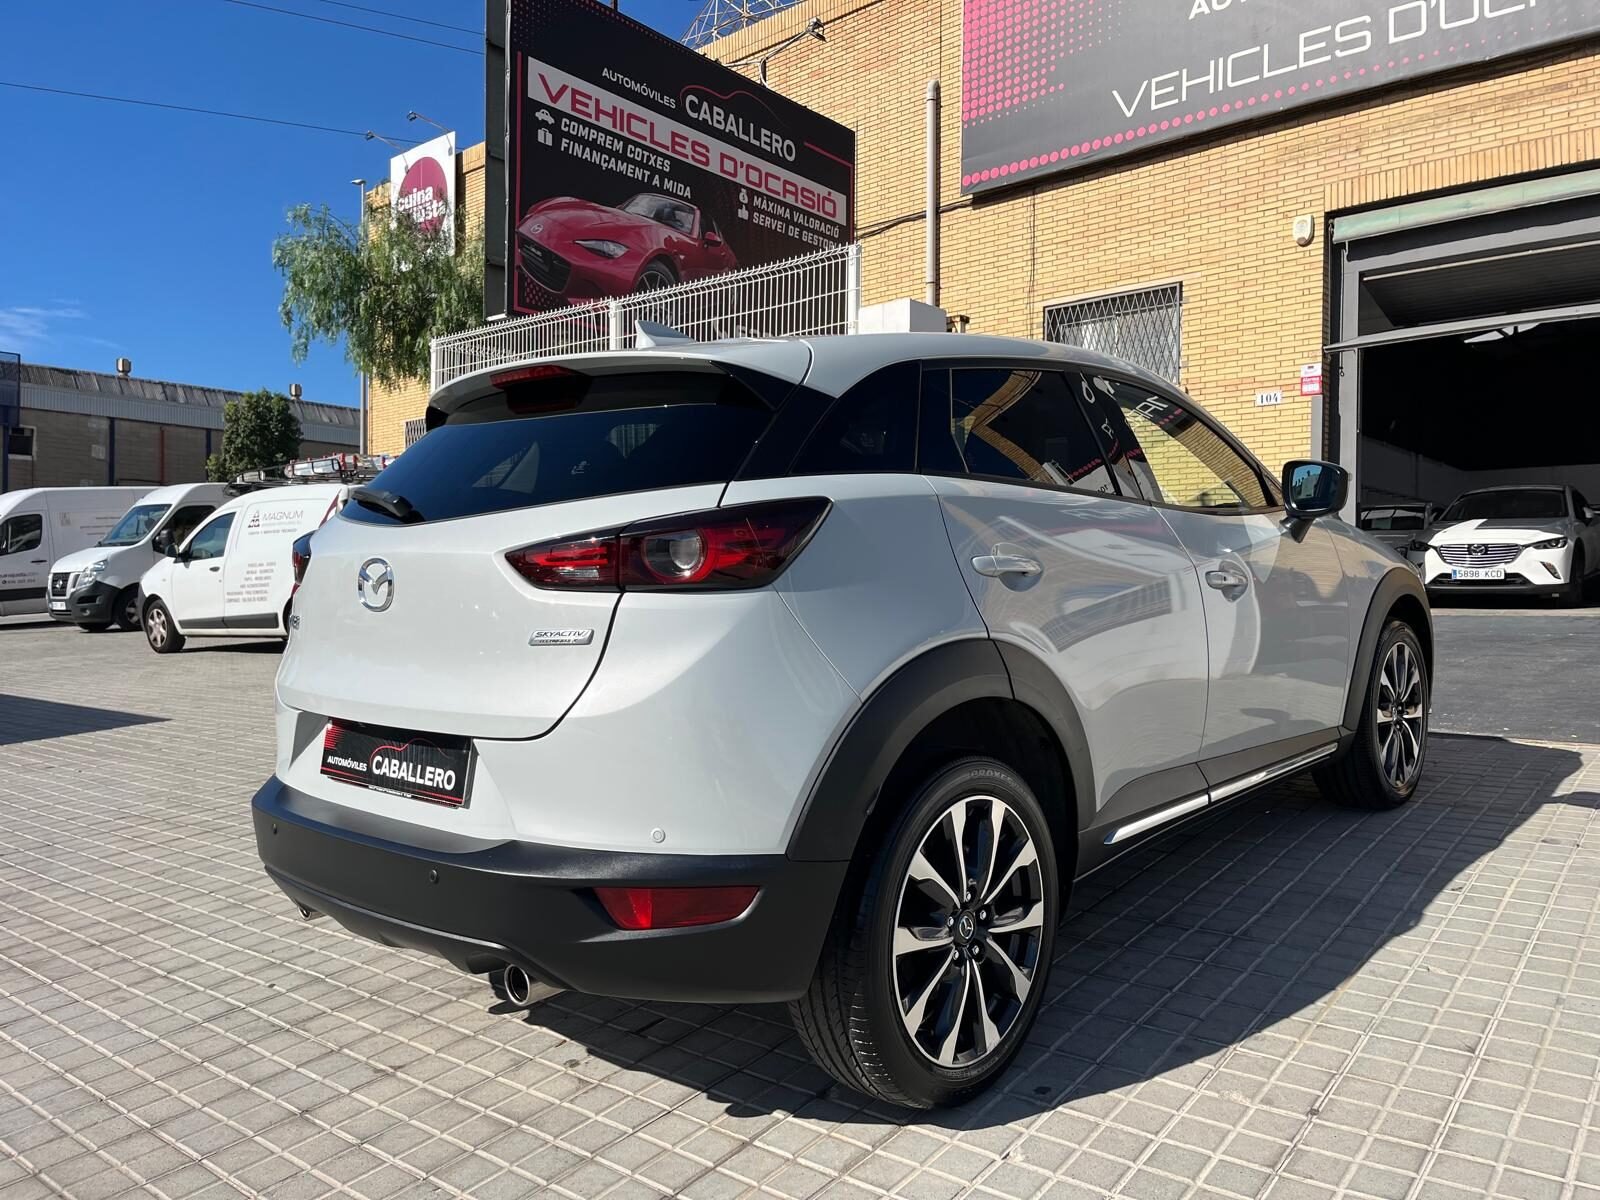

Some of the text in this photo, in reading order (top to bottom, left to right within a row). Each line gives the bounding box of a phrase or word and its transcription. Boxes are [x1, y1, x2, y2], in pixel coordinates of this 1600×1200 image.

[1112, 15, 1371, 118] VEHICLES
[602, 67, 796, 161] AUTOMÓVILES CABALLERO
[538, 73, 837, 218] VEHICLES D'OCASIÓ
[561, 118, 671, 172] COMPREM COTXES
[561, 138, 691, 199] FINANÇAMENT A MIDA
[398, 186, 433, 211] cuina
[753, 212, 785, 234] SERVEI
[788, 225, 800, 239] DE
[793, 210, 840, 238] VALORACIÓ
[1261, 393, 1278, 404] 104
[1458, 570, 1502, 578] 5898 KCD
[327, 755, 456, 790] AUTOMÓVILES CABALLERO
